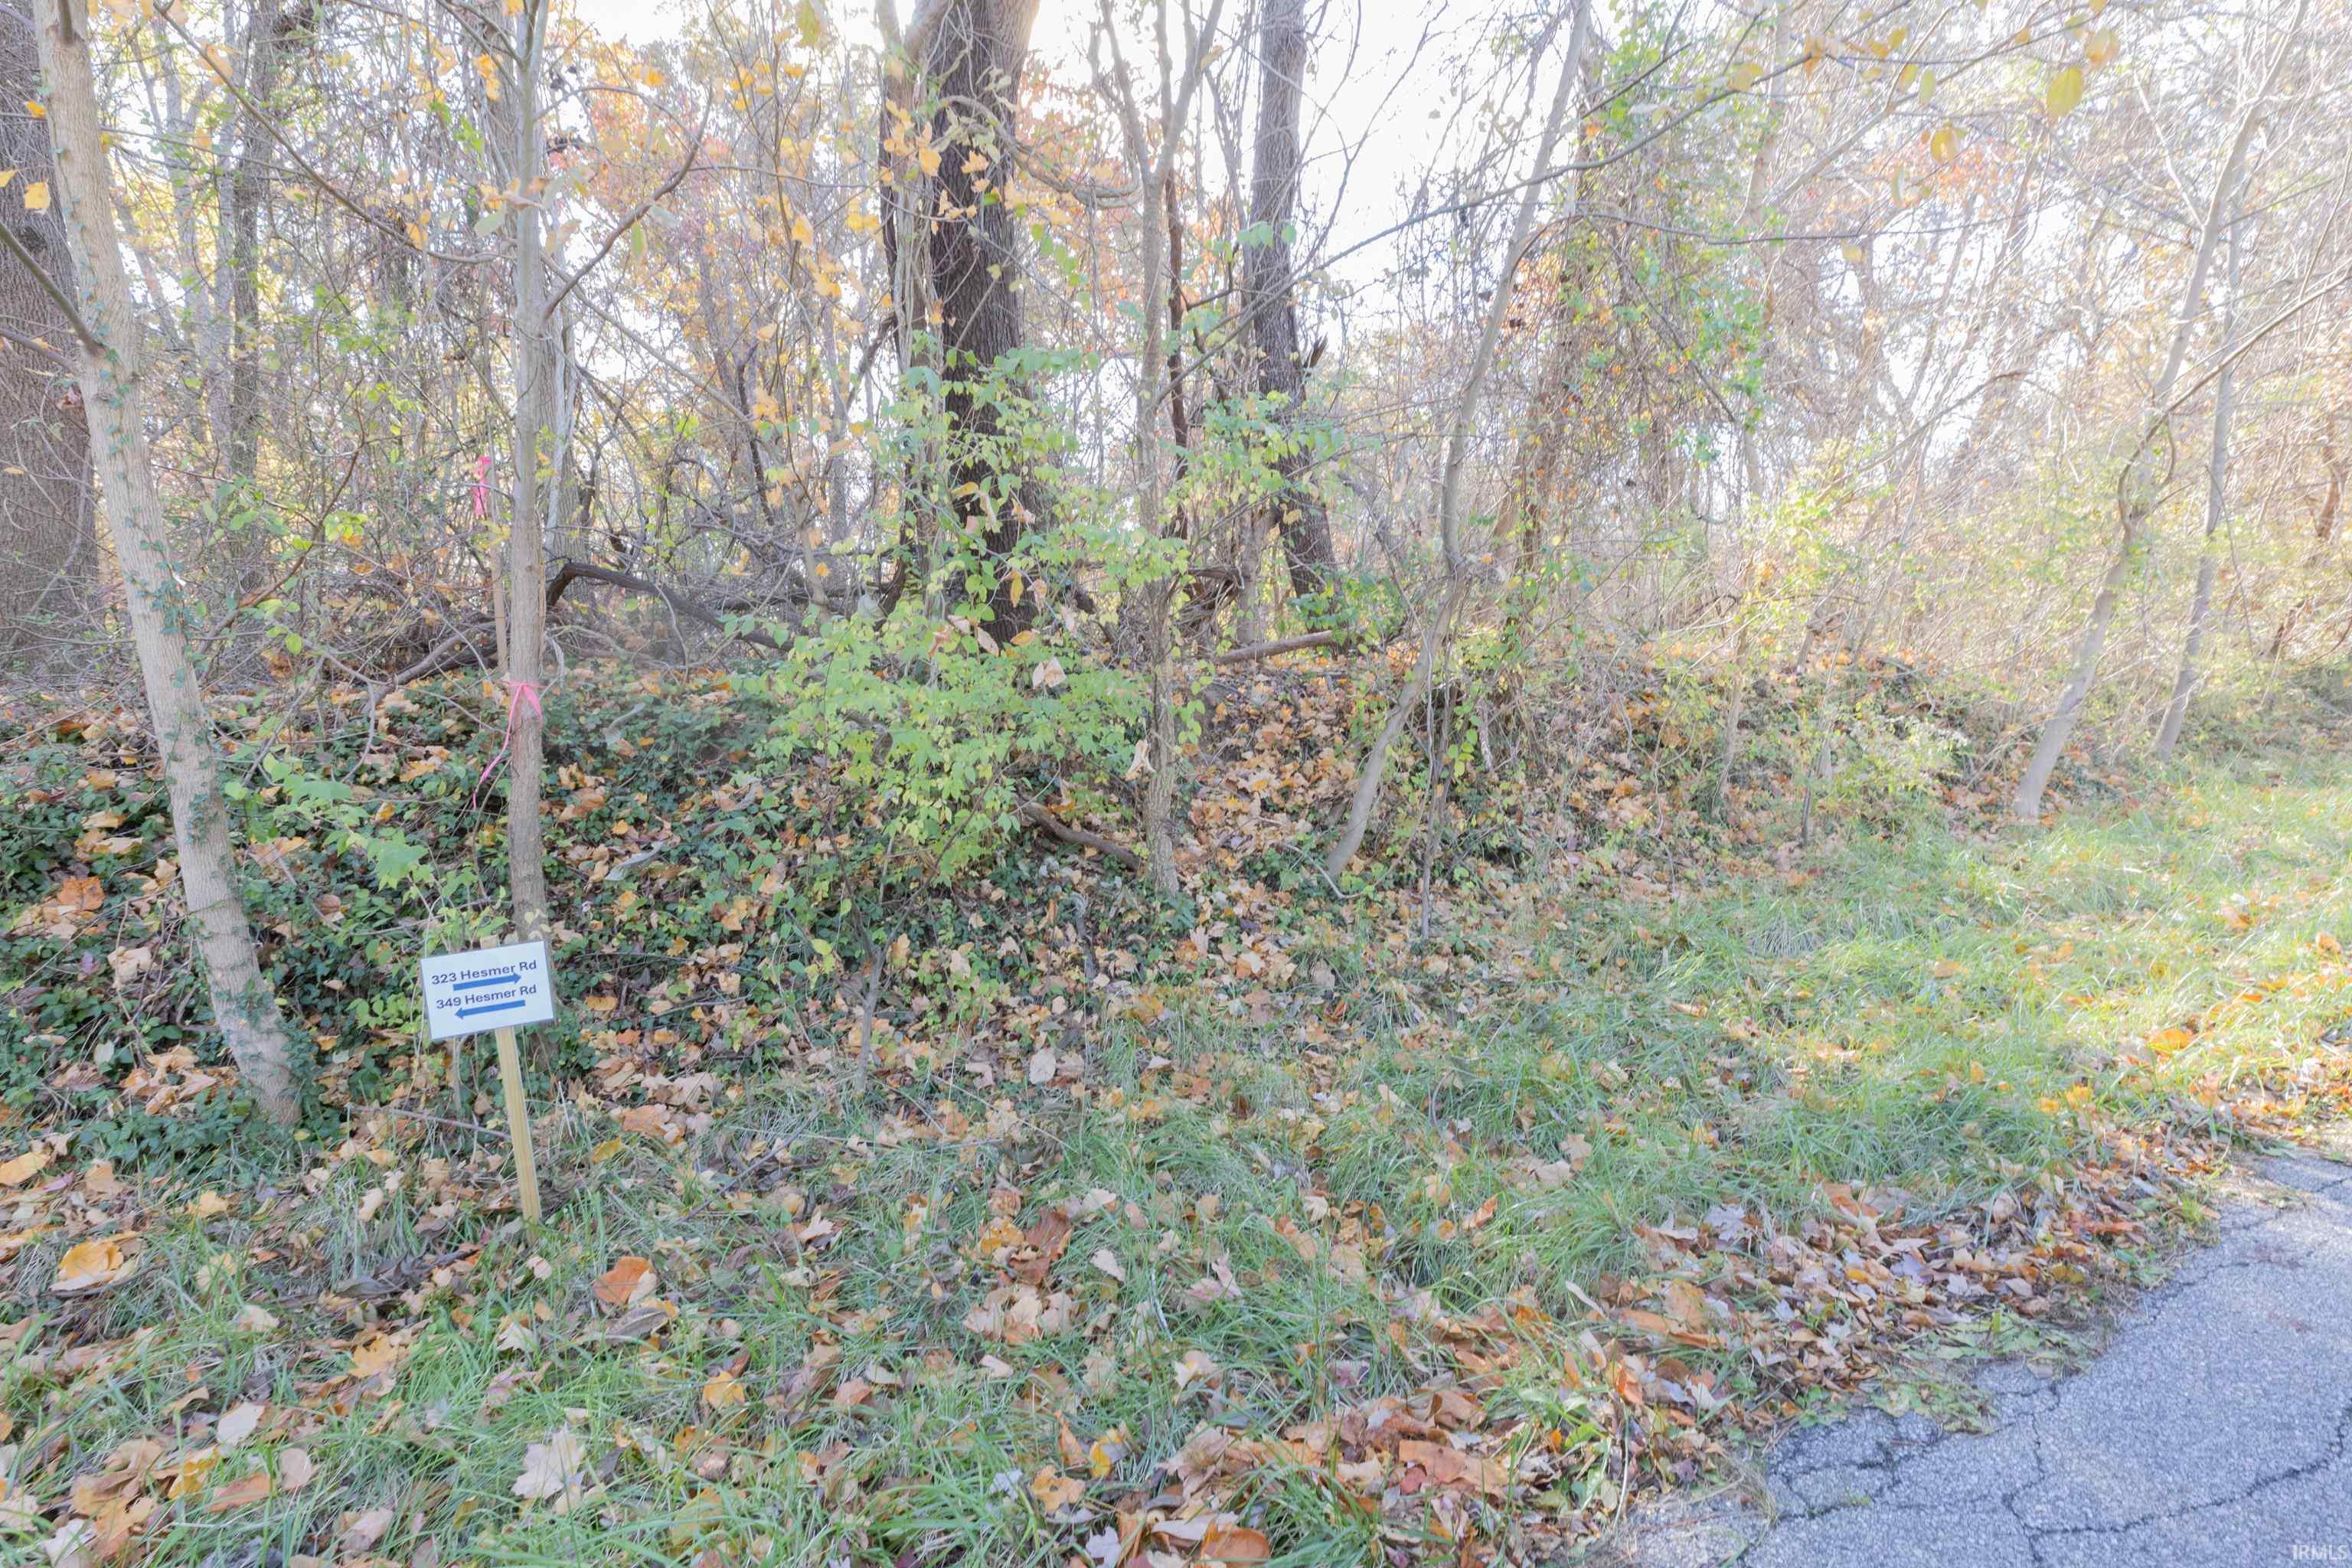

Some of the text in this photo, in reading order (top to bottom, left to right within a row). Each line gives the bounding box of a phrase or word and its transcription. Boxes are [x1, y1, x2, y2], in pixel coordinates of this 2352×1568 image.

[431, 960, 537, 985] 323 Hesmer Rd
[436, 985, 537, 1009] 349 Hesmer Rd
